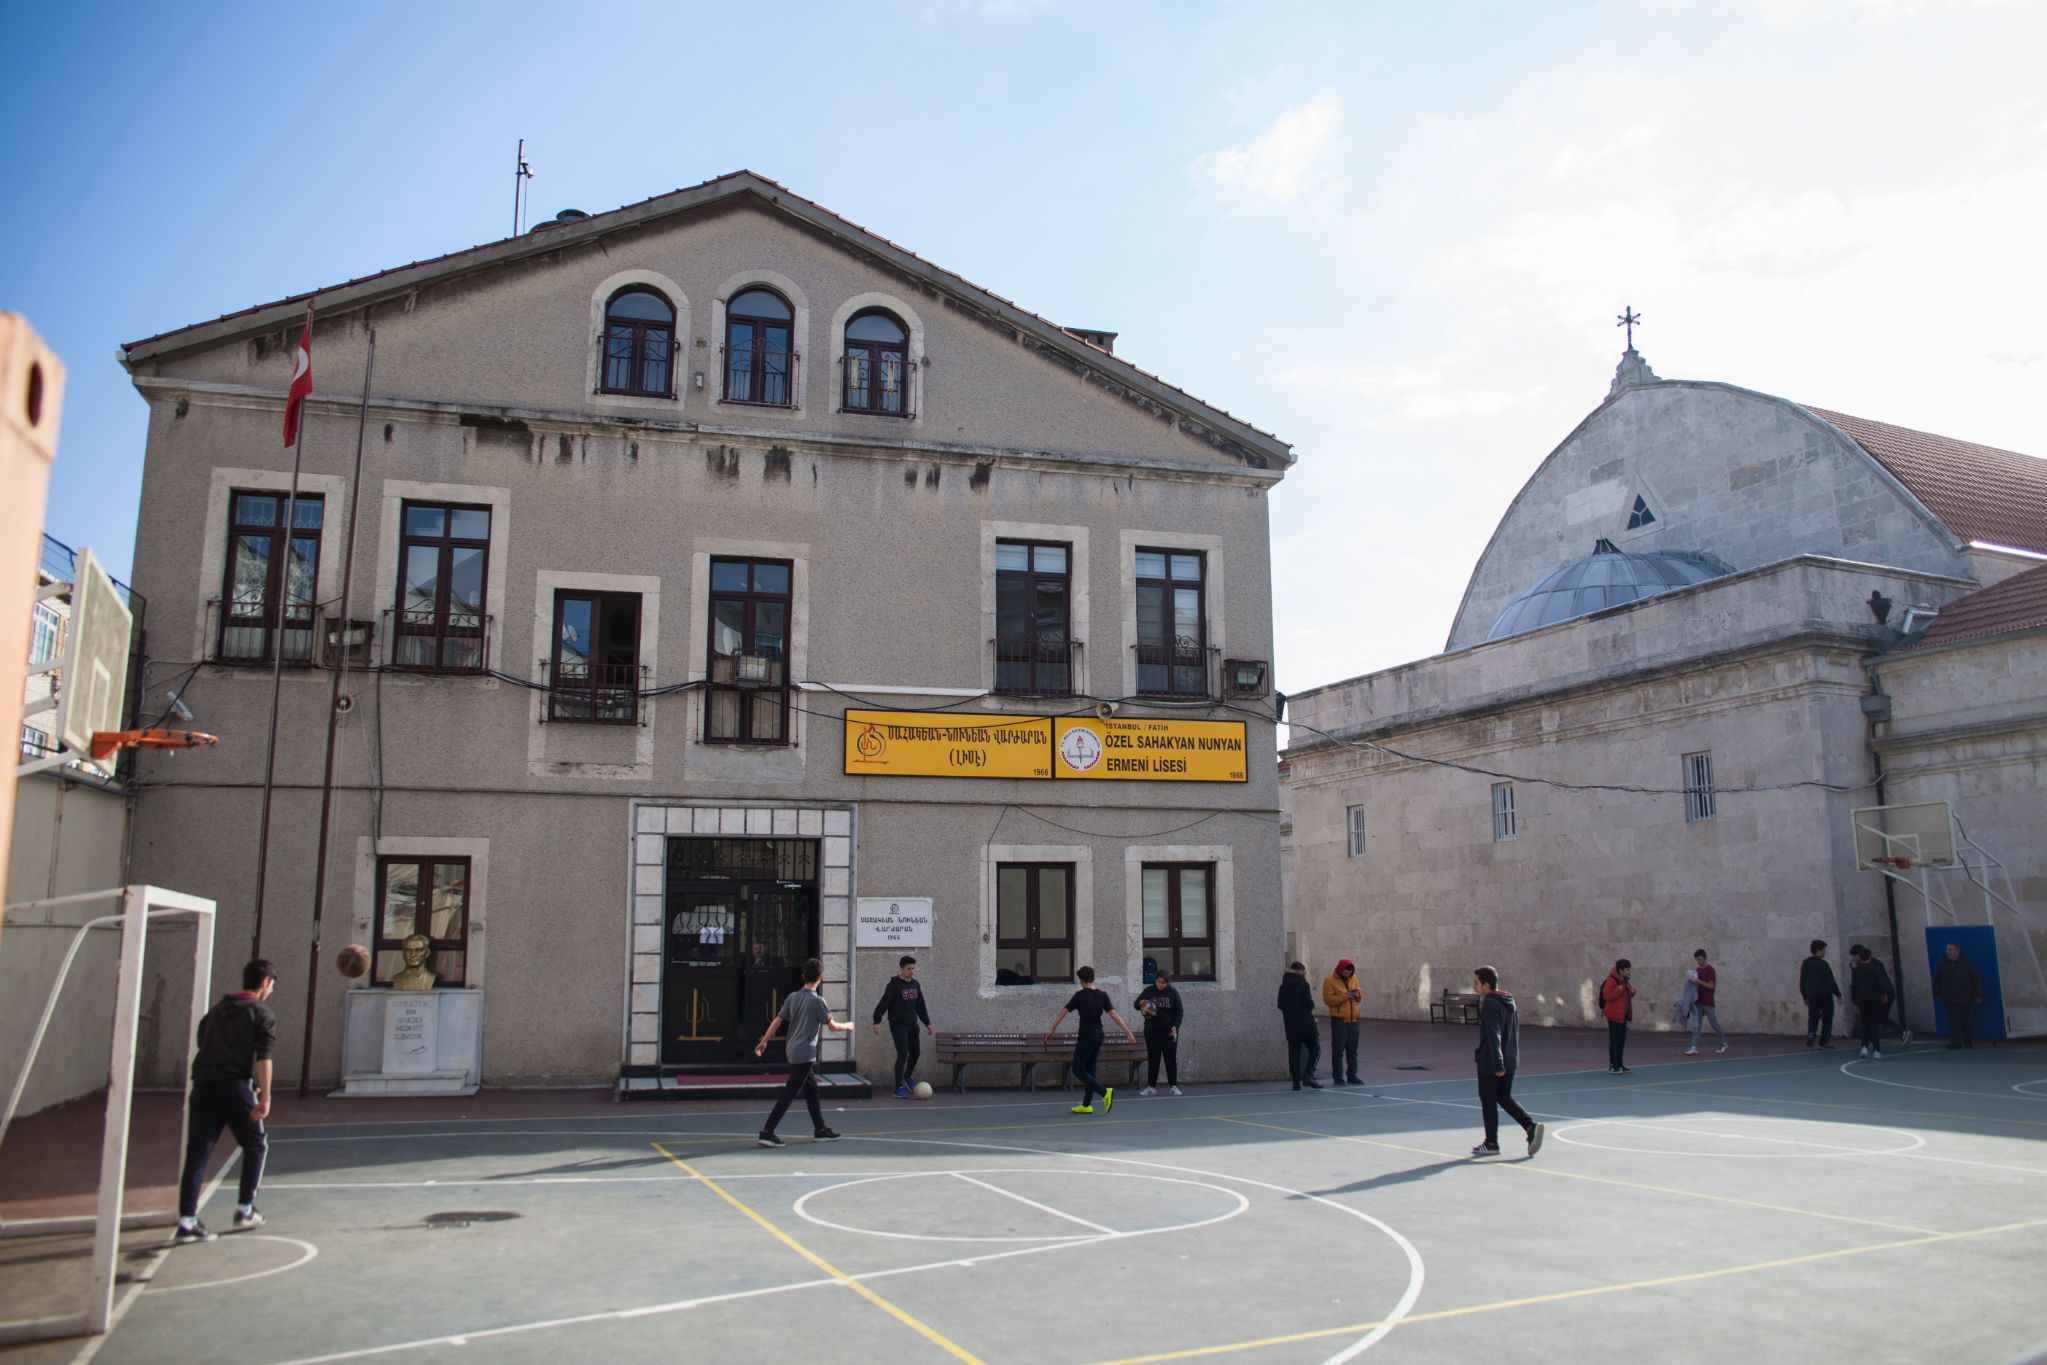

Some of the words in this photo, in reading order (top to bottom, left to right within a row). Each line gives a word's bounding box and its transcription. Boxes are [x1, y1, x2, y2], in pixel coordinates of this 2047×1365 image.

[1105, 722, 1141, 731] İSTANBUL
[1148, 723, 1169, 731] FATİH
[994, 729, 1047, 745] ՎԱՐԺԱՐԱՆ
[1105, 731, 1134, 748] ÖZEL
[1137, 735, 1195, 750] SAHAKYAN
[1198, 737, 1242, 751] NUNYAN
[1033, 768, 1049, 776] 1966
[1106, 756, 1149, 772] ERMENİ
[1153, 756, 1187, 773] LİSESİ
